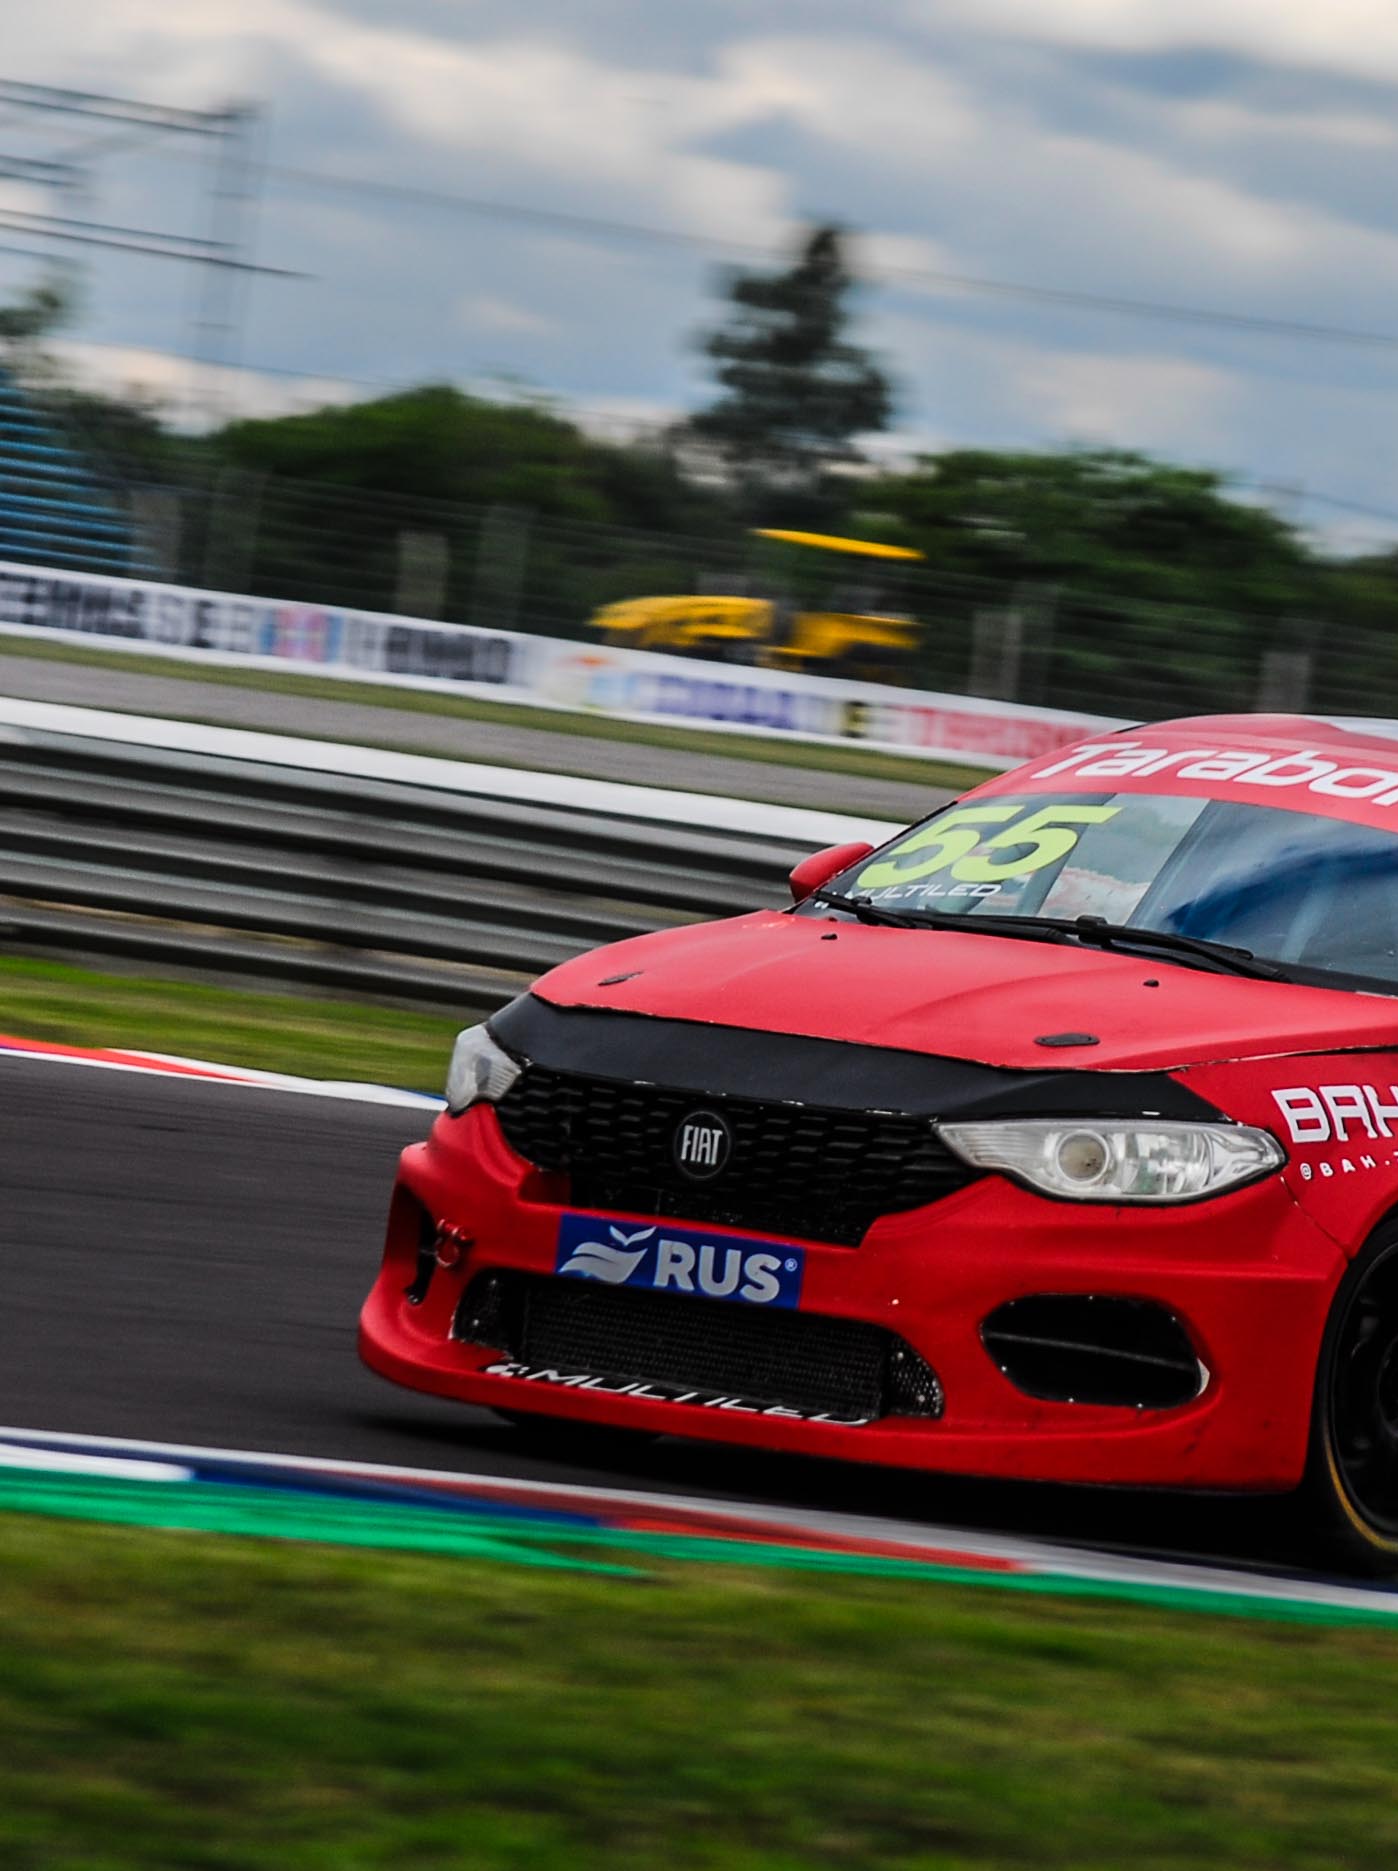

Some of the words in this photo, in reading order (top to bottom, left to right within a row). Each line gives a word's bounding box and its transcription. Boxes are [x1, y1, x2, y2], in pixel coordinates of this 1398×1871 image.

[857, 805, 1124, 888] 55
[680, 1124, 723, 1165] FIAT
[653, 1239, 782, 1303] RUS
